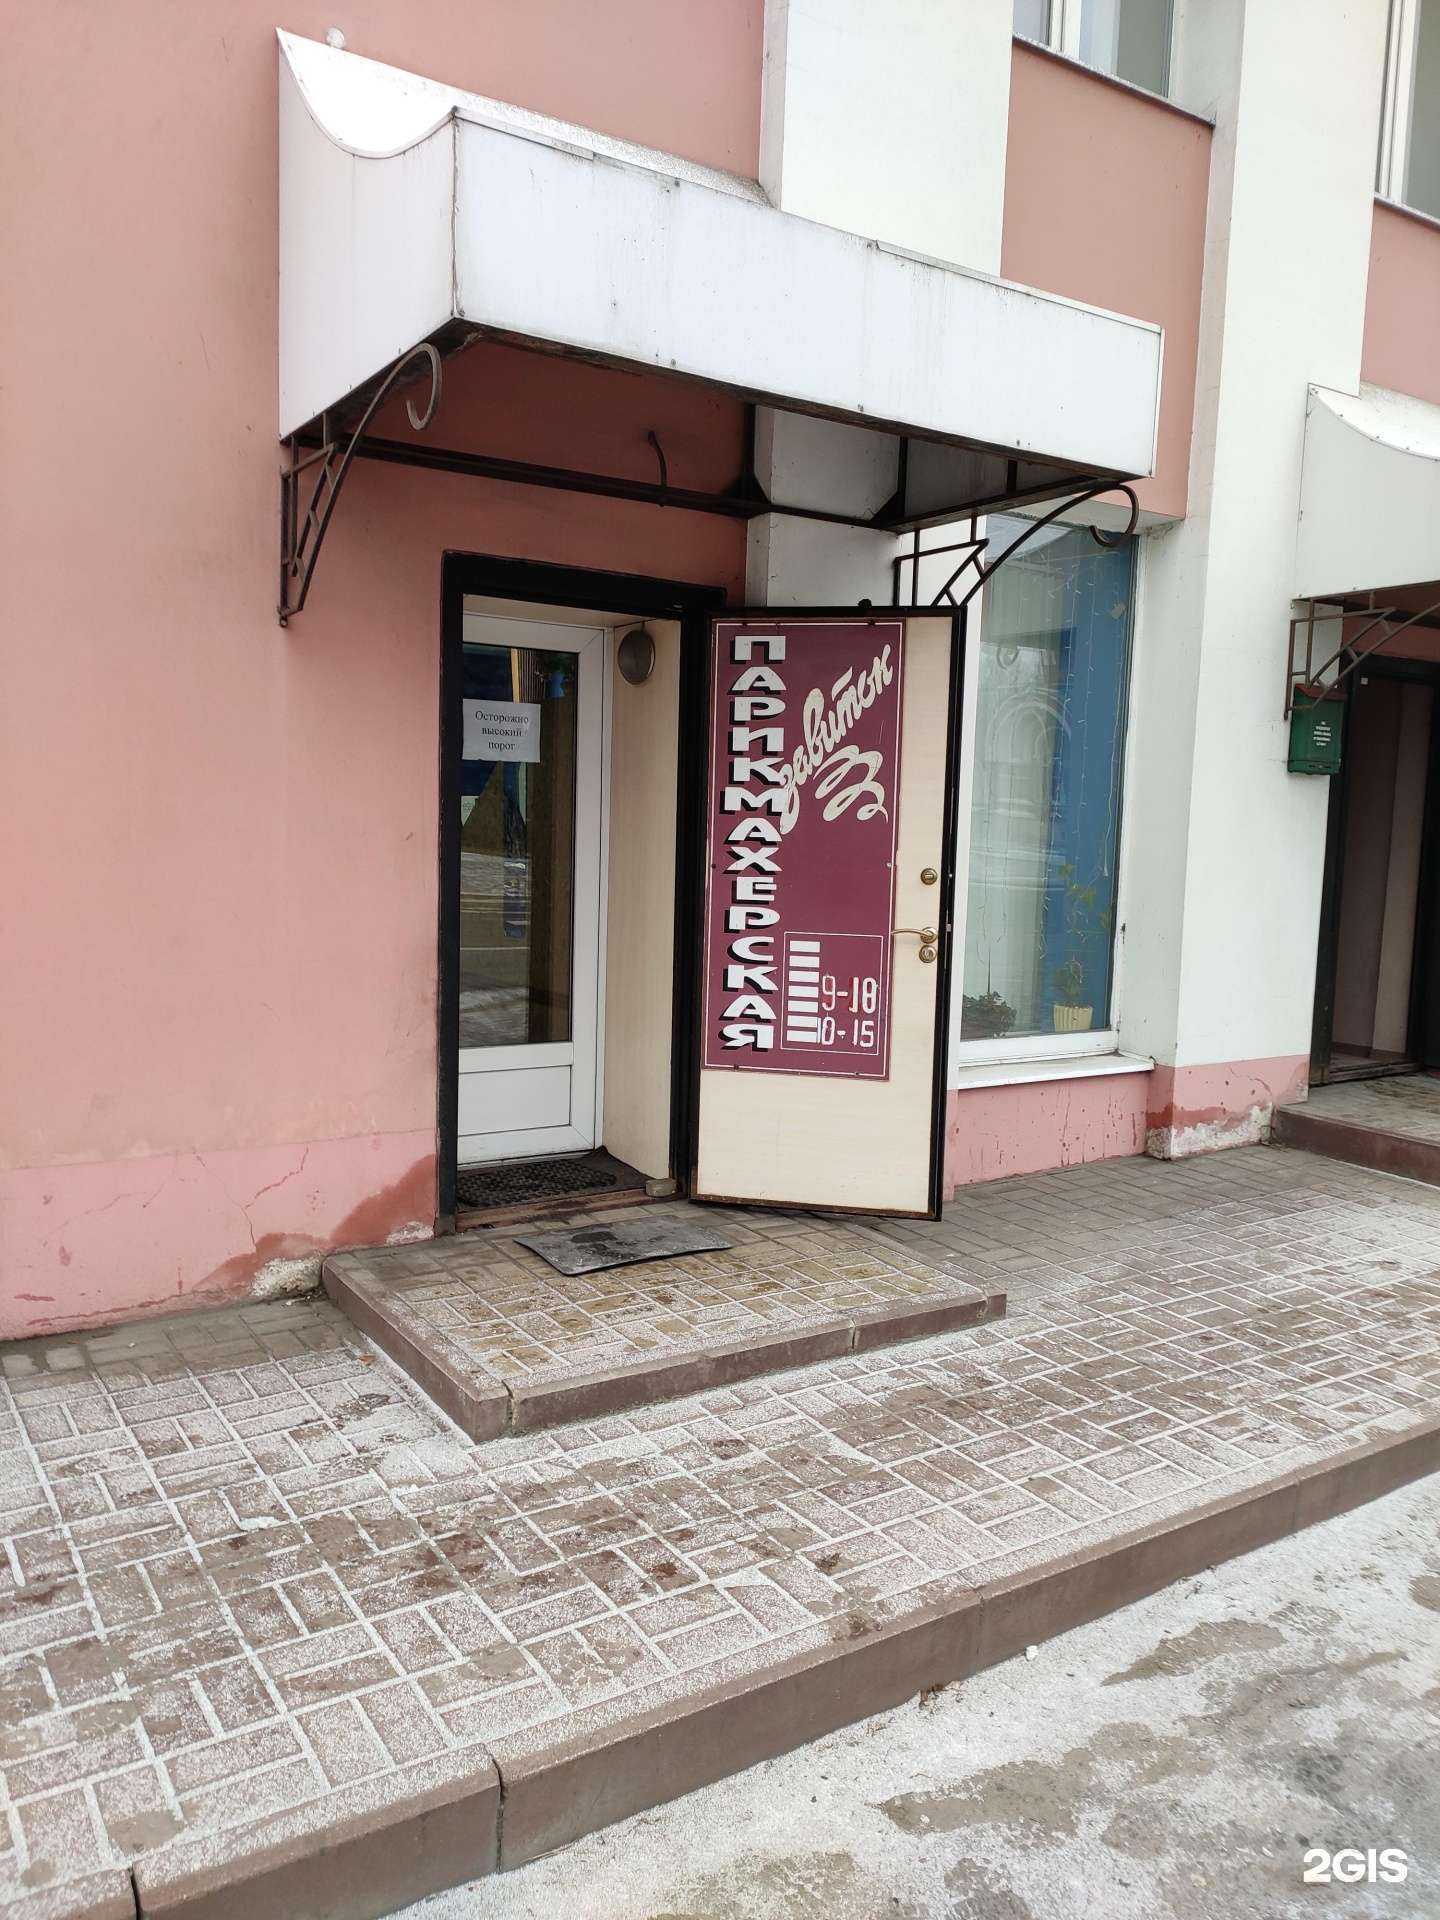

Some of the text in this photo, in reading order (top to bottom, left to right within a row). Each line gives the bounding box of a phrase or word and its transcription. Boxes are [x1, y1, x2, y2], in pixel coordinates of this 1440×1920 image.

[475, 711, 529, 724] Осторожно
[481, 727, 522, 737] высокий
[488, 741, 516, 752] порог
[720, 635, 786, 1050] ПАРИКМАХЕРСКАЯ
